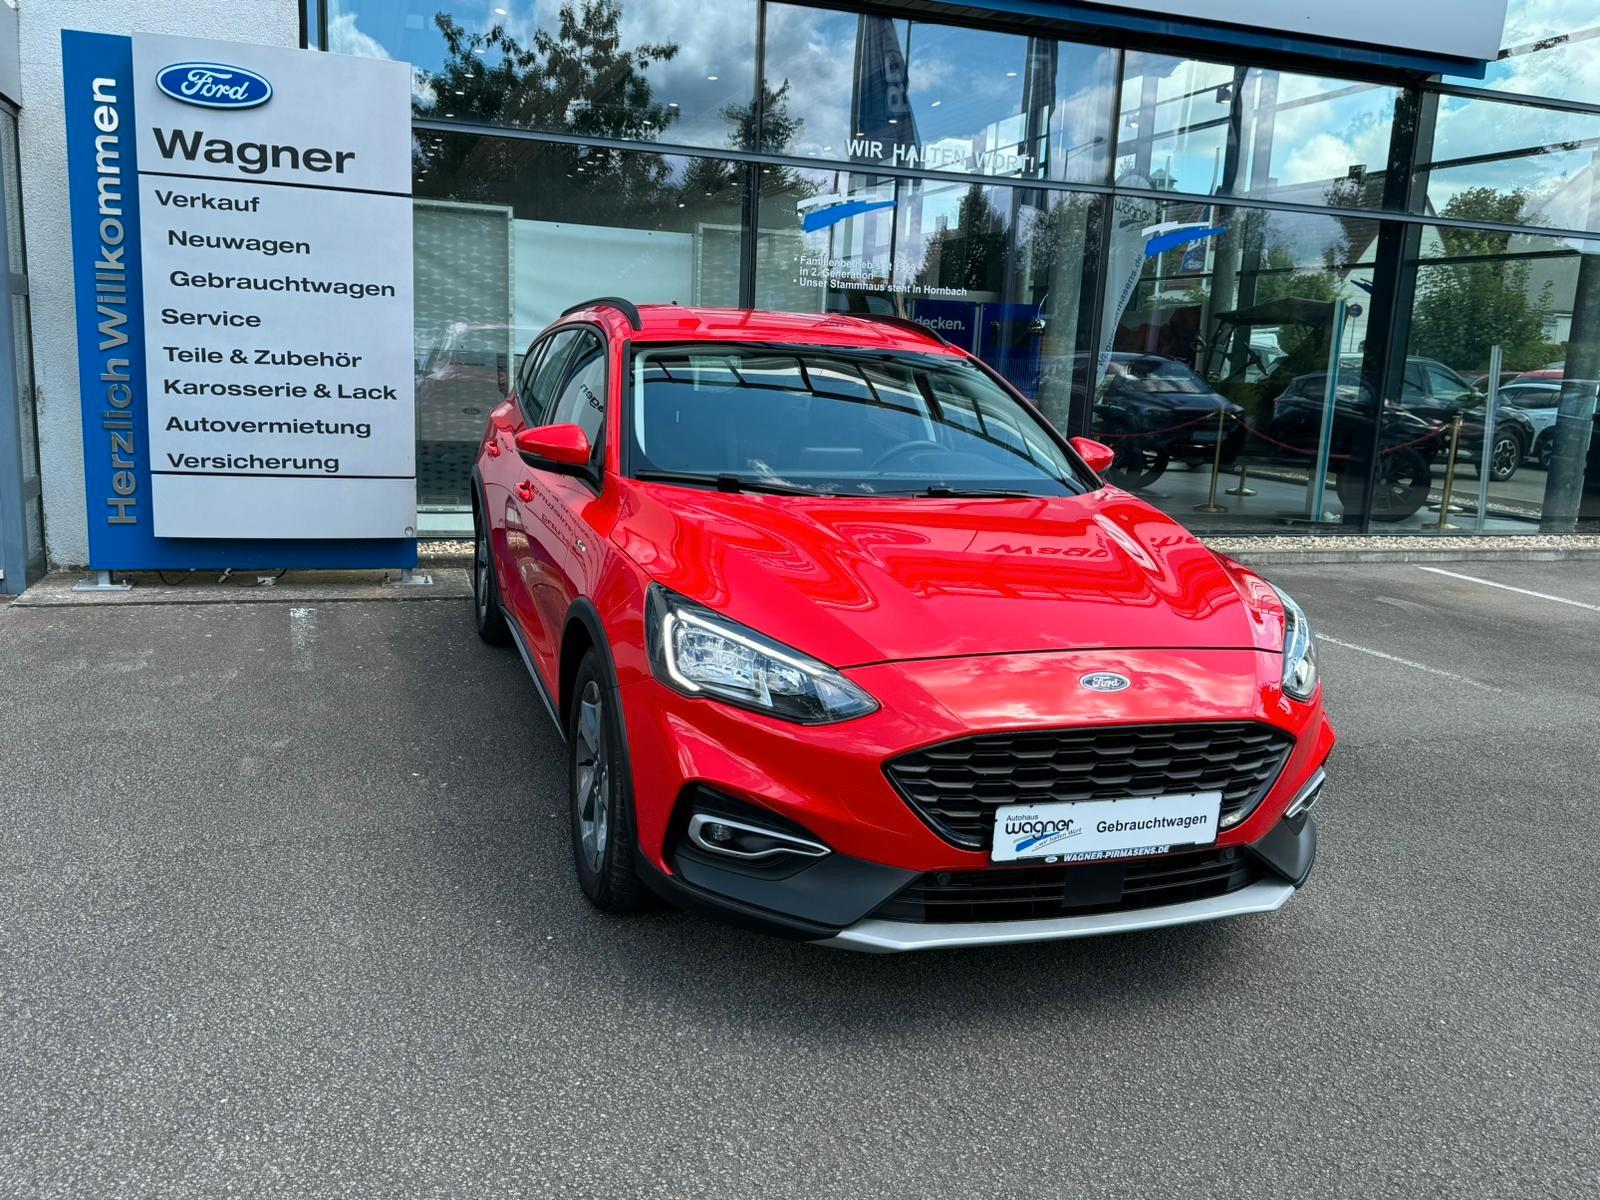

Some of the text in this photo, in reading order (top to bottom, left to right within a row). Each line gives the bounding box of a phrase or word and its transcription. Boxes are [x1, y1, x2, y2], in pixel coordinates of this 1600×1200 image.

[153, 127, 356, 175] Wagner
[846, 138, 883, 159] WIR
[154, 190, 260, 213] Verkauf
[168, 230, 311, 255] Neuwagen
[800, 255, 873, 270] Familienbetrieb
[800, 267, 874, 280] in 2. Generation
[170, 270, 395, 299] Gebrauchtwagen
[799, 279, 967, 296] Unser Stammhaus steht in Hornbach
[91, 76, 137, 524] Herzlich Willkommen
[161, 308, 262, 328] Service
[163, 347, 362, 368] Teile & Zubehör
[164, 379, 397, 400] Karosserie & Lack
[165, 416, 371, 438] Autovermietung
[167, 453, 340, 473] Versicherung
[1005, 813, 1208, 840] wagner Gebrauchtwagen
[1006, 814, 1039, 822] Autohaus
[1063, 845, 1171, 863] WAGNER-PIRMASENS.DE
